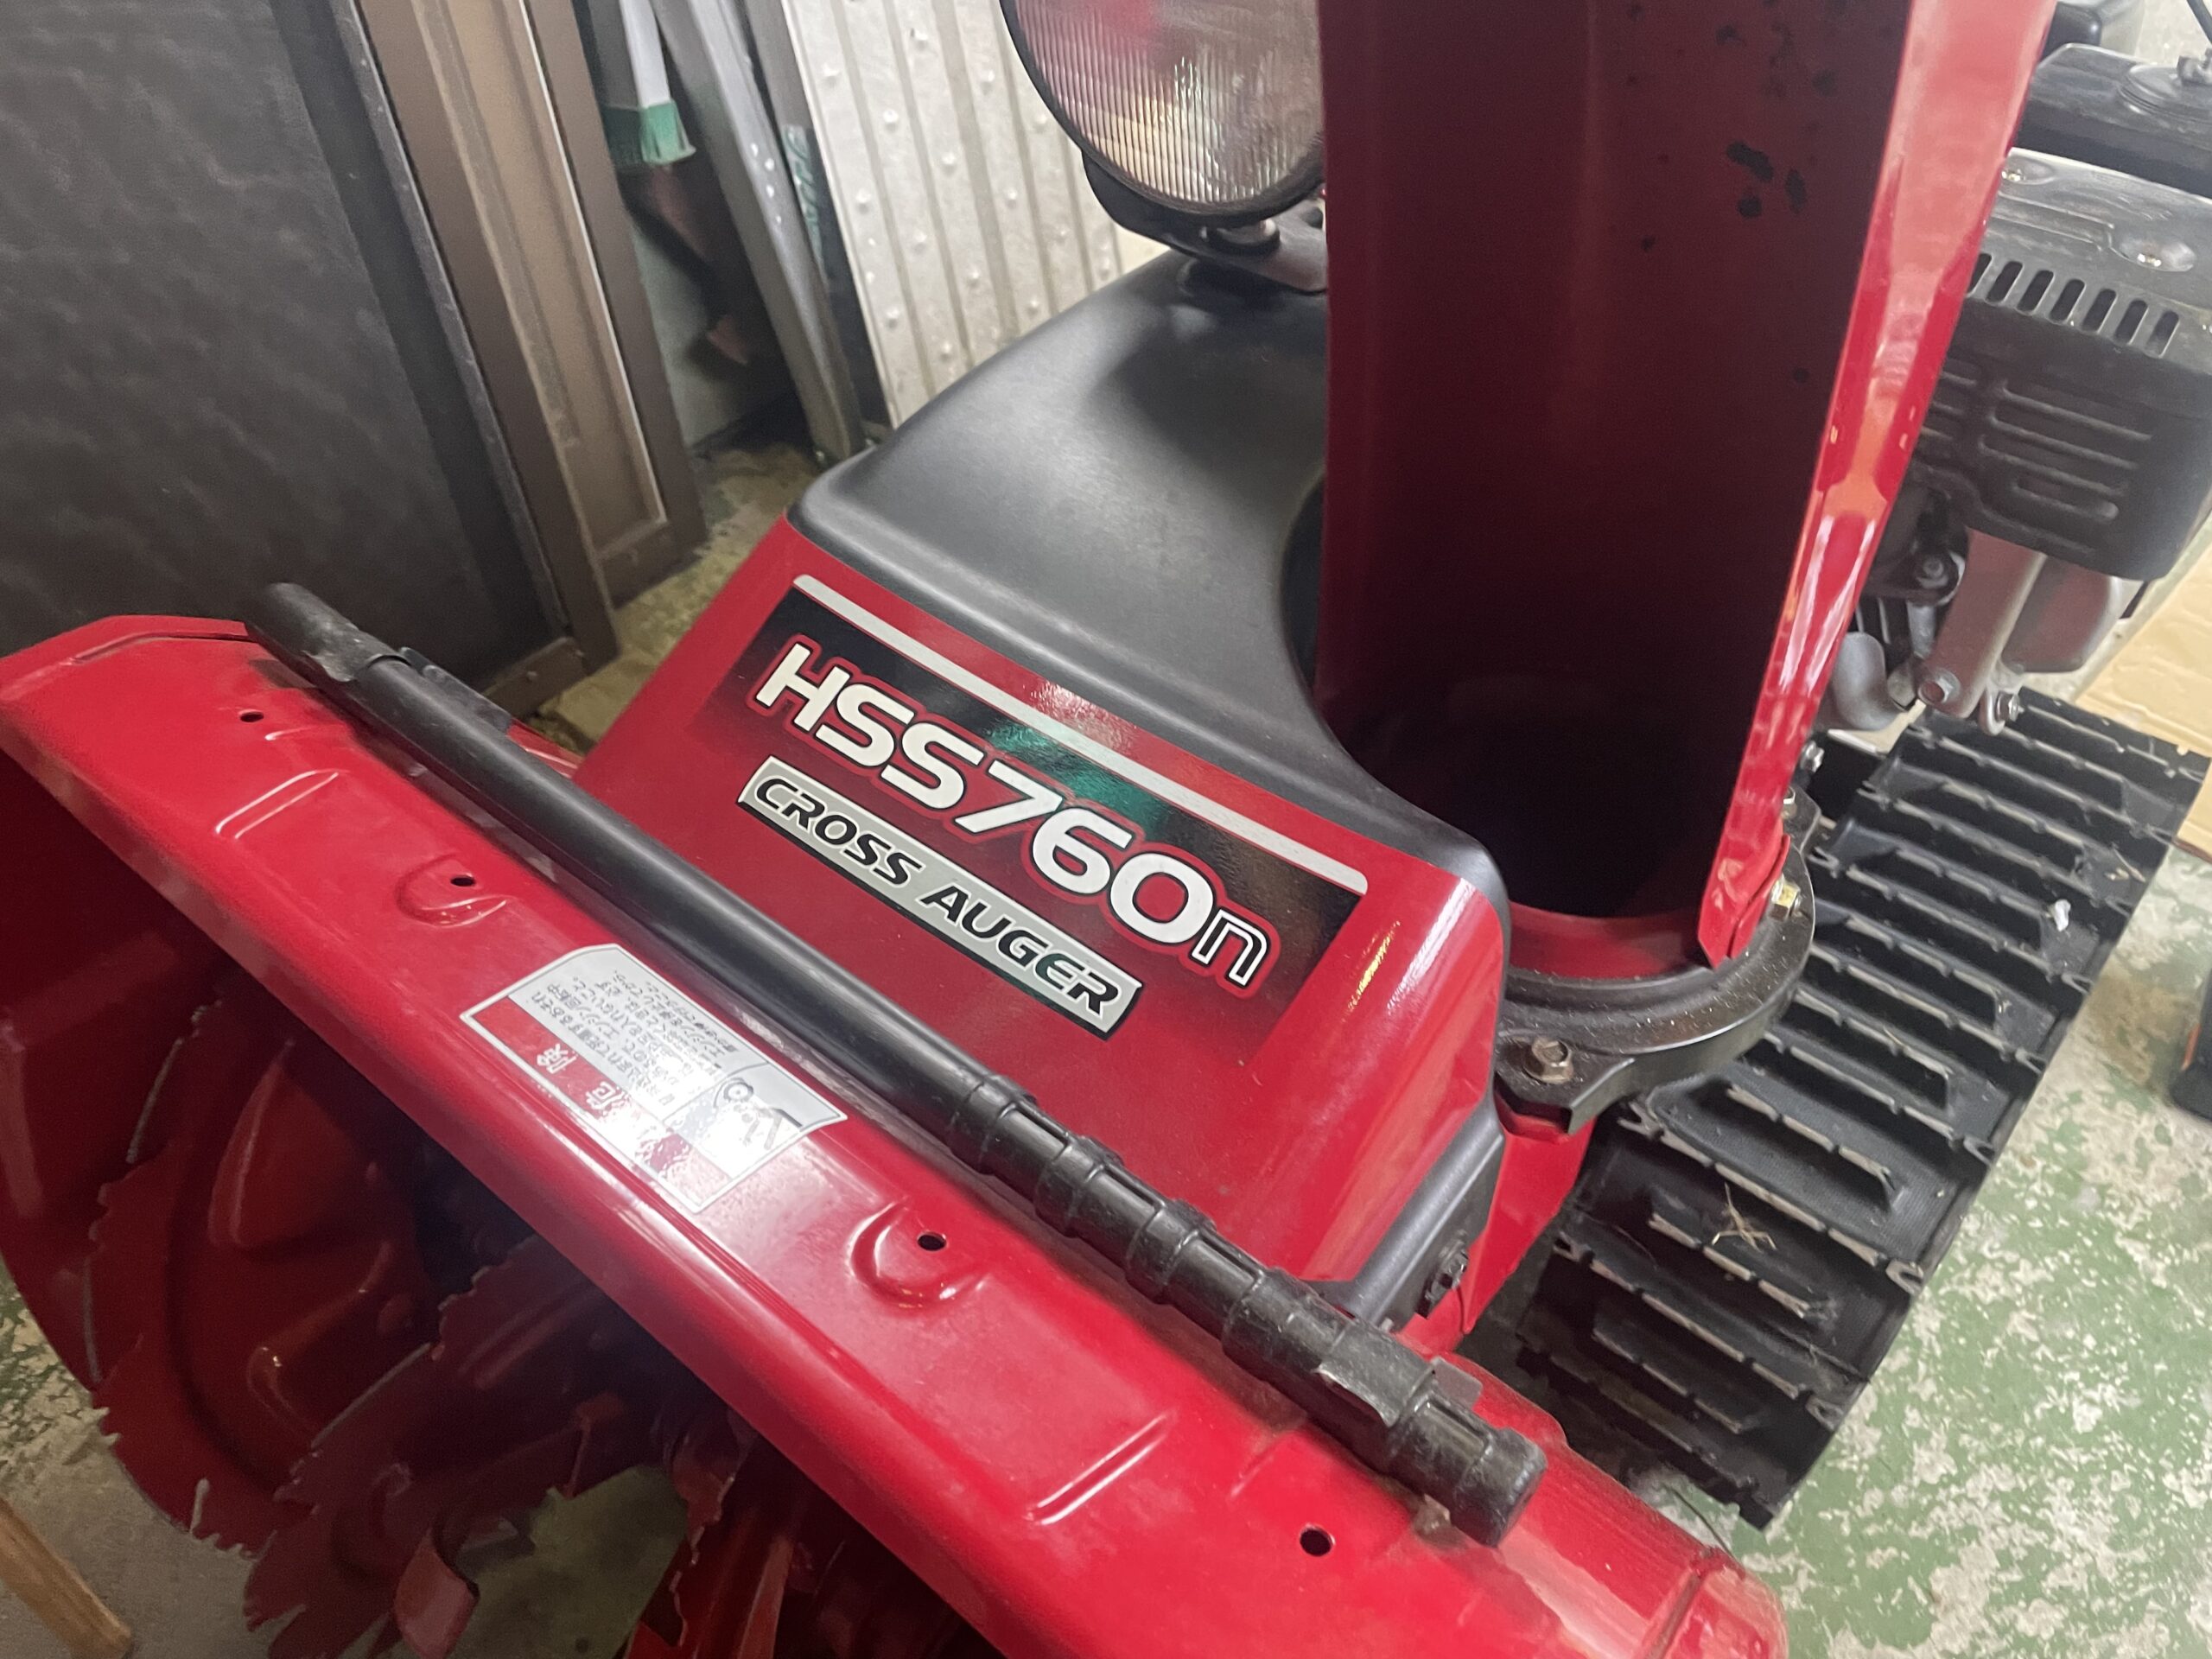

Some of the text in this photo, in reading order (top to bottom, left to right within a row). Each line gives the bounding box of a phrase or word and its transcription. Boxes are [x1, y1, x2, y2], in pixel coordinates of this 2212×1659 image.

[753, 642, 1269, 987] HSS760n
[754, 777, 1120, 1015] CROSS AUGER
